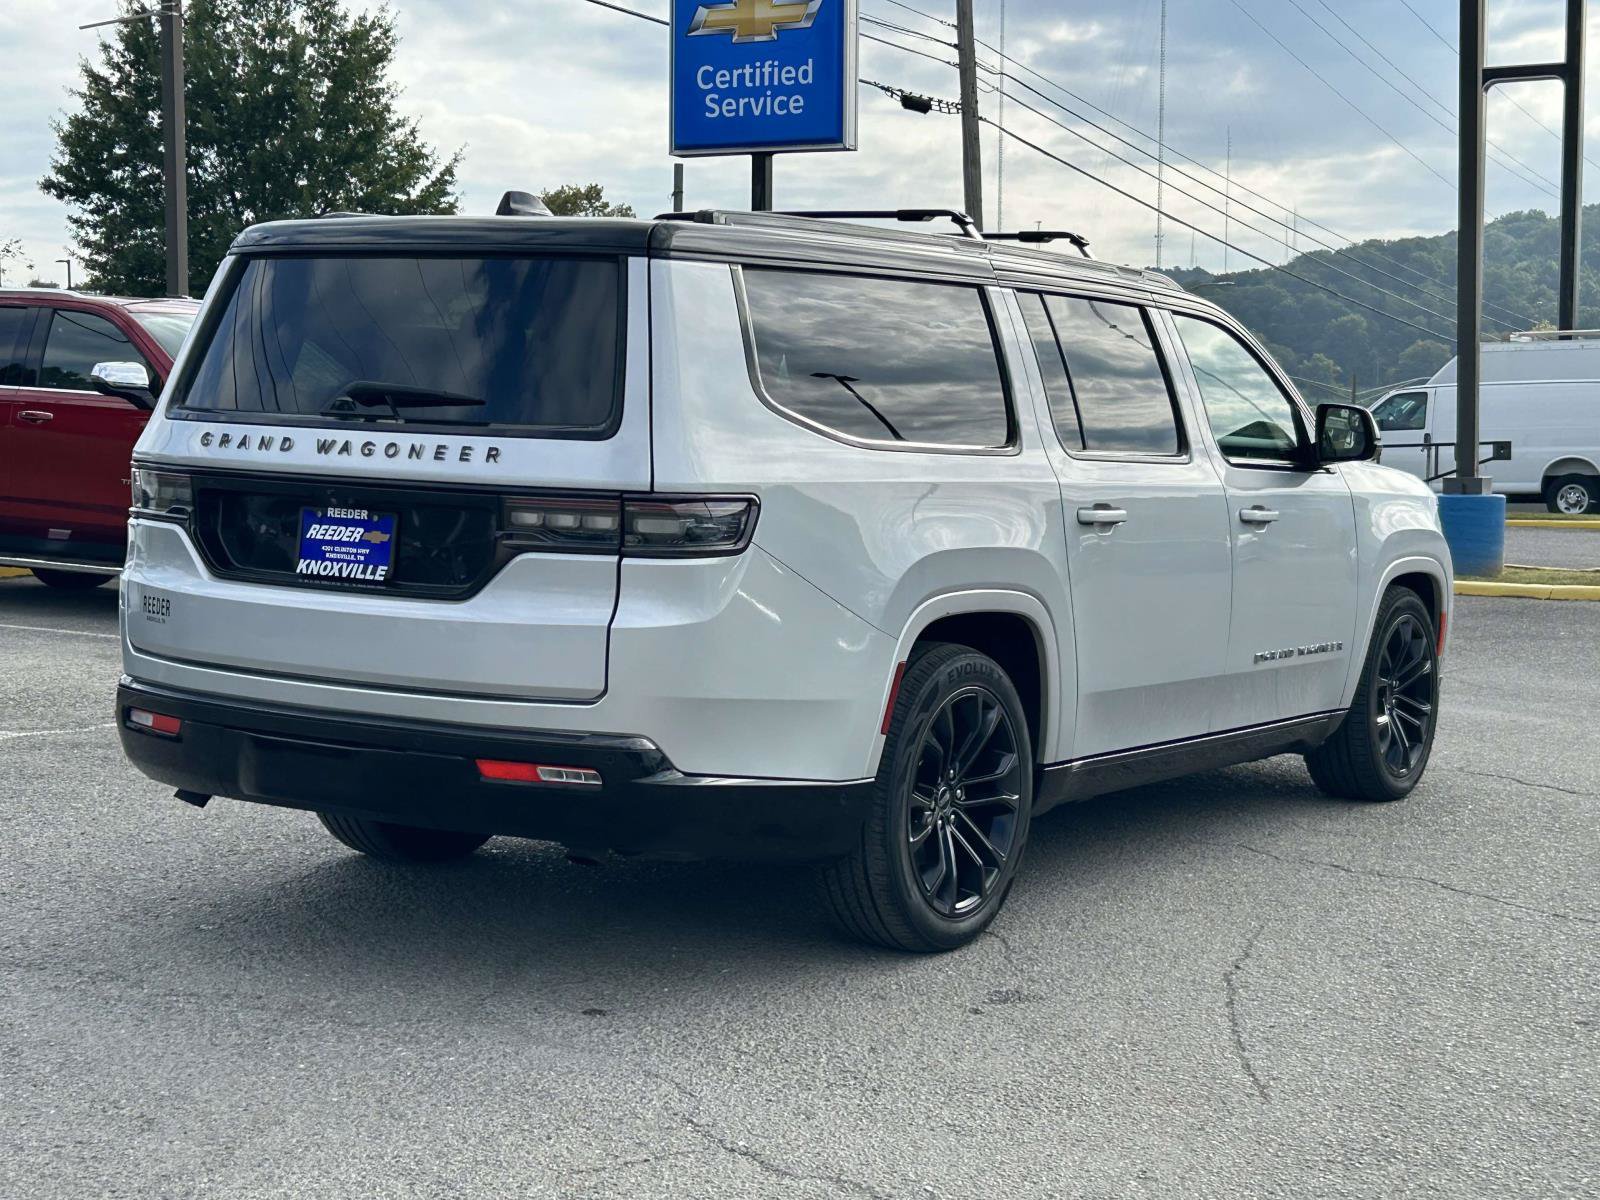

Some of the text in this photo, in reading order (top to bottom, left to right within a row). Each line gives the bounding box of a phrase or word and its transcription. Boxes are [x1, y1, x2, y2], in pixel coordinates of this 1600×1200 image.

[697, 59, 813, 90] Certified
[705, 90, 804, 118] Service
[200, 431, 502, 463] GRAND WAGONEER
[328, 507, 368, 520] REEDER
[306, 524, 365, 542] REEDER
[296, 559, 389, 581] KNOXVILLE
[143, 595, 171, 616] REEDER
